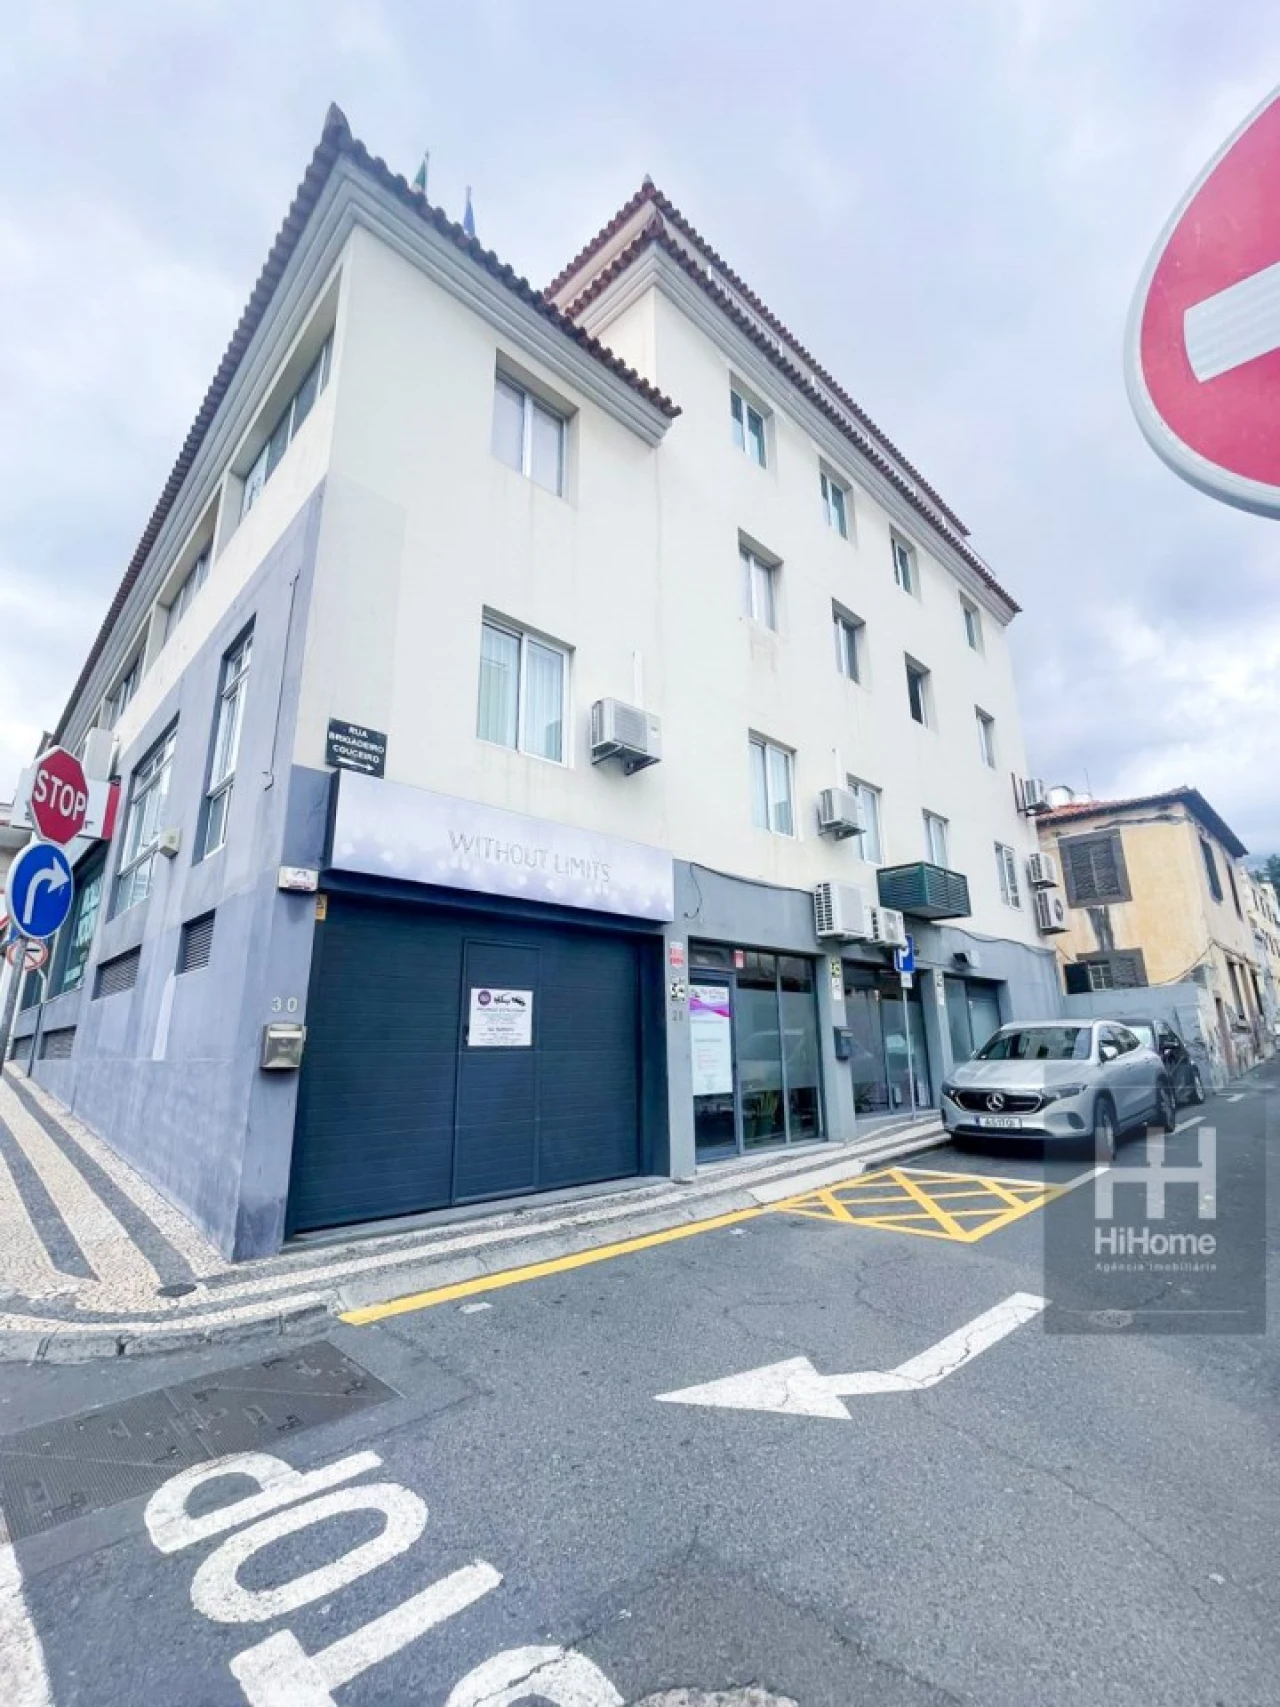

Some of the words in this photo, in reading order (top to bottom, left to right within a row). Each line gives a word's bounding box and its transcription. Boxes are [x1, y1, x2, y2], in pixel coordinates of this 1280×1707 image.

[348, 726, 368, 738] RUA
[328, 732, 385, 754] BRIGADEIRO
[332, 744, 380, 763] COUCEIRO
[34, 769, 86, 820] STOP
[448, 830, 548, 868] WITHOUT
[554, 853, 613, 882] LIMITS
[271, 997, 299, 1013] 30
